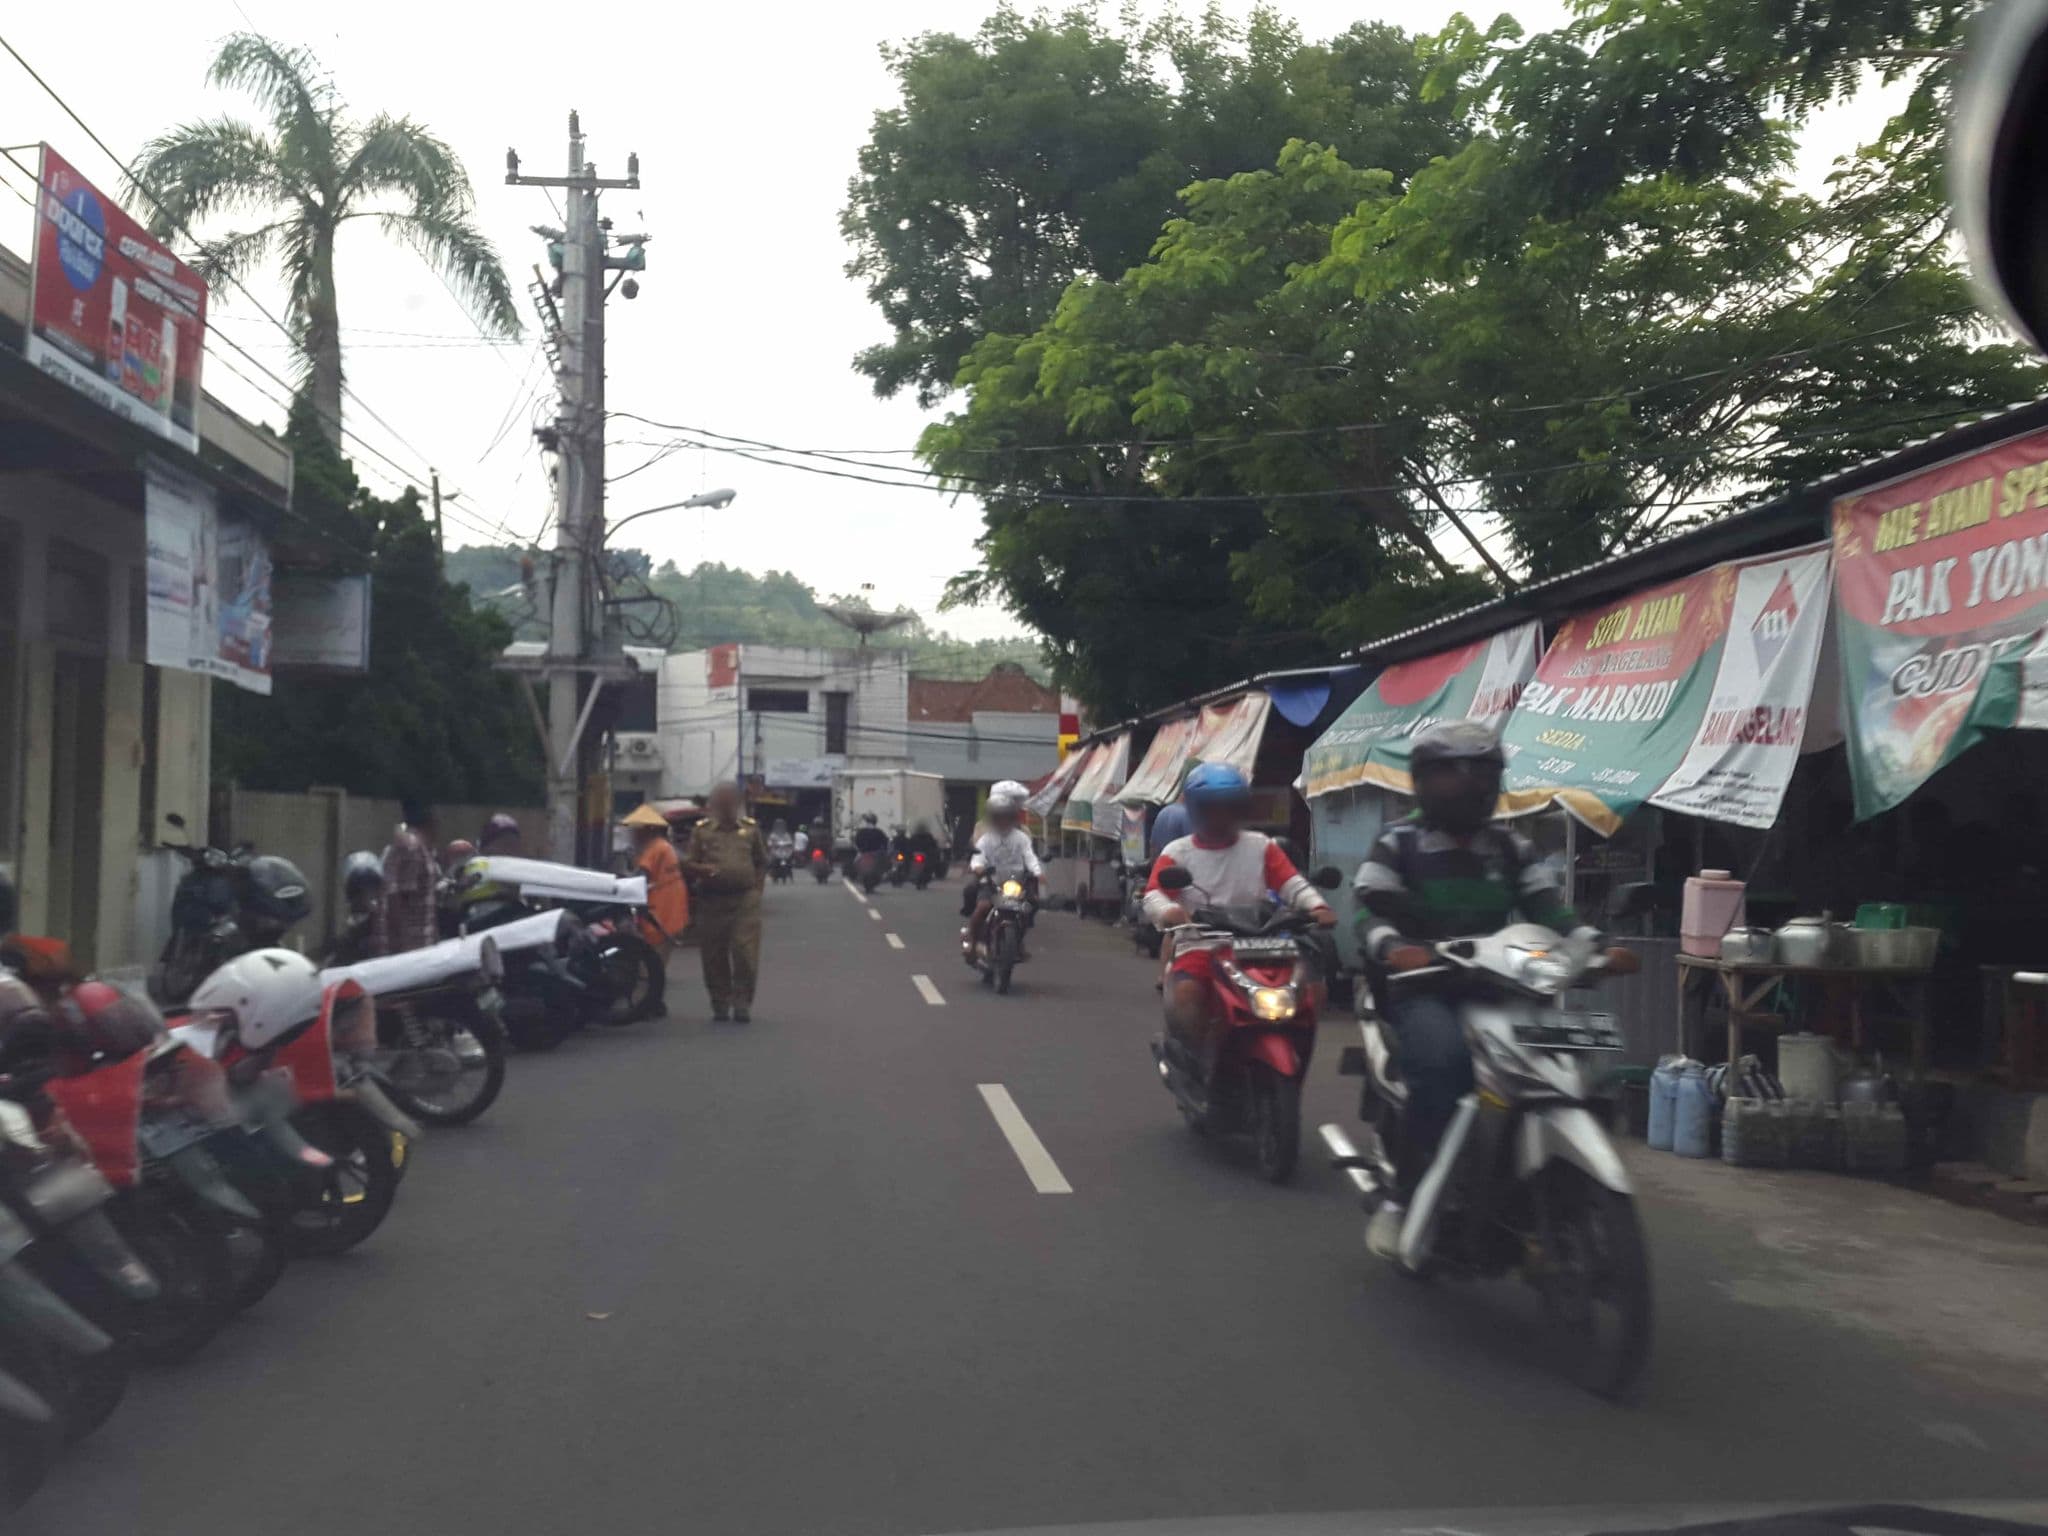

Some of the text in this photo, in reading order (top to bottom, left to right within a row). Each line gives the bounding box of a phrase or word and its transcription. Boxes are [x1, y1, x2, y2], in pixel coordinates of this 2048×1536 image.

[1873, 502, 1923, 553] MIE
[1922, 477, 1995, 541] AYAM
[1585, 593, 1686, 651] SOTO AYAM
[1879, 556, 1959, 626] PAK
[1517, 680, 1576, 715] PAK
[1560, 680, 1679, 722] MARSUDI
